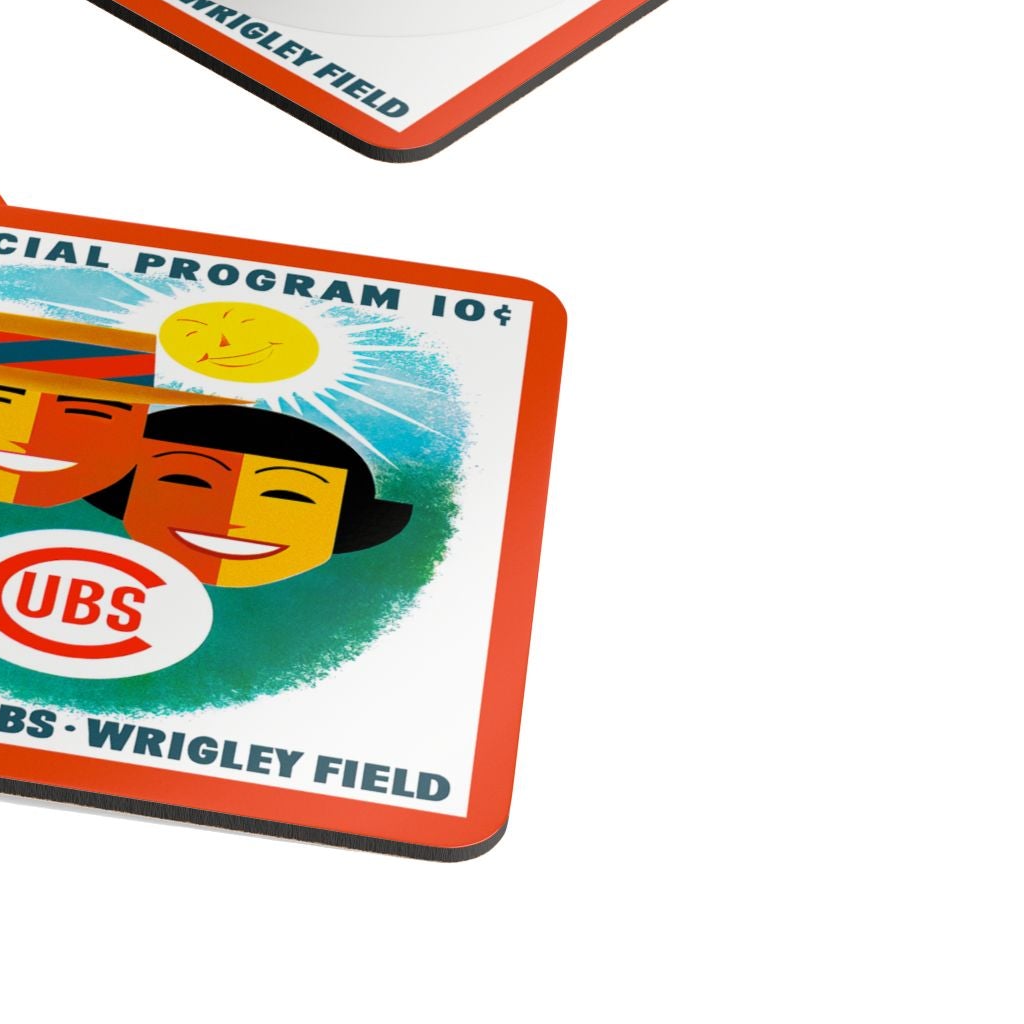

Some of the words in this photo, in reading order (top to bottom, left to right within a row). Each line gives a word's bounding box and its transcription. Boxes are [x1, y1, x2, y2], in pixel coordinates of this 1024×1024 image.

[312, 62, 410, 118] FIELD
[133, 252, 401, 311] PROGRAM
[87, 717, 305, 778] WRIGLEY
[313, 755, 451, 802] FIELD
